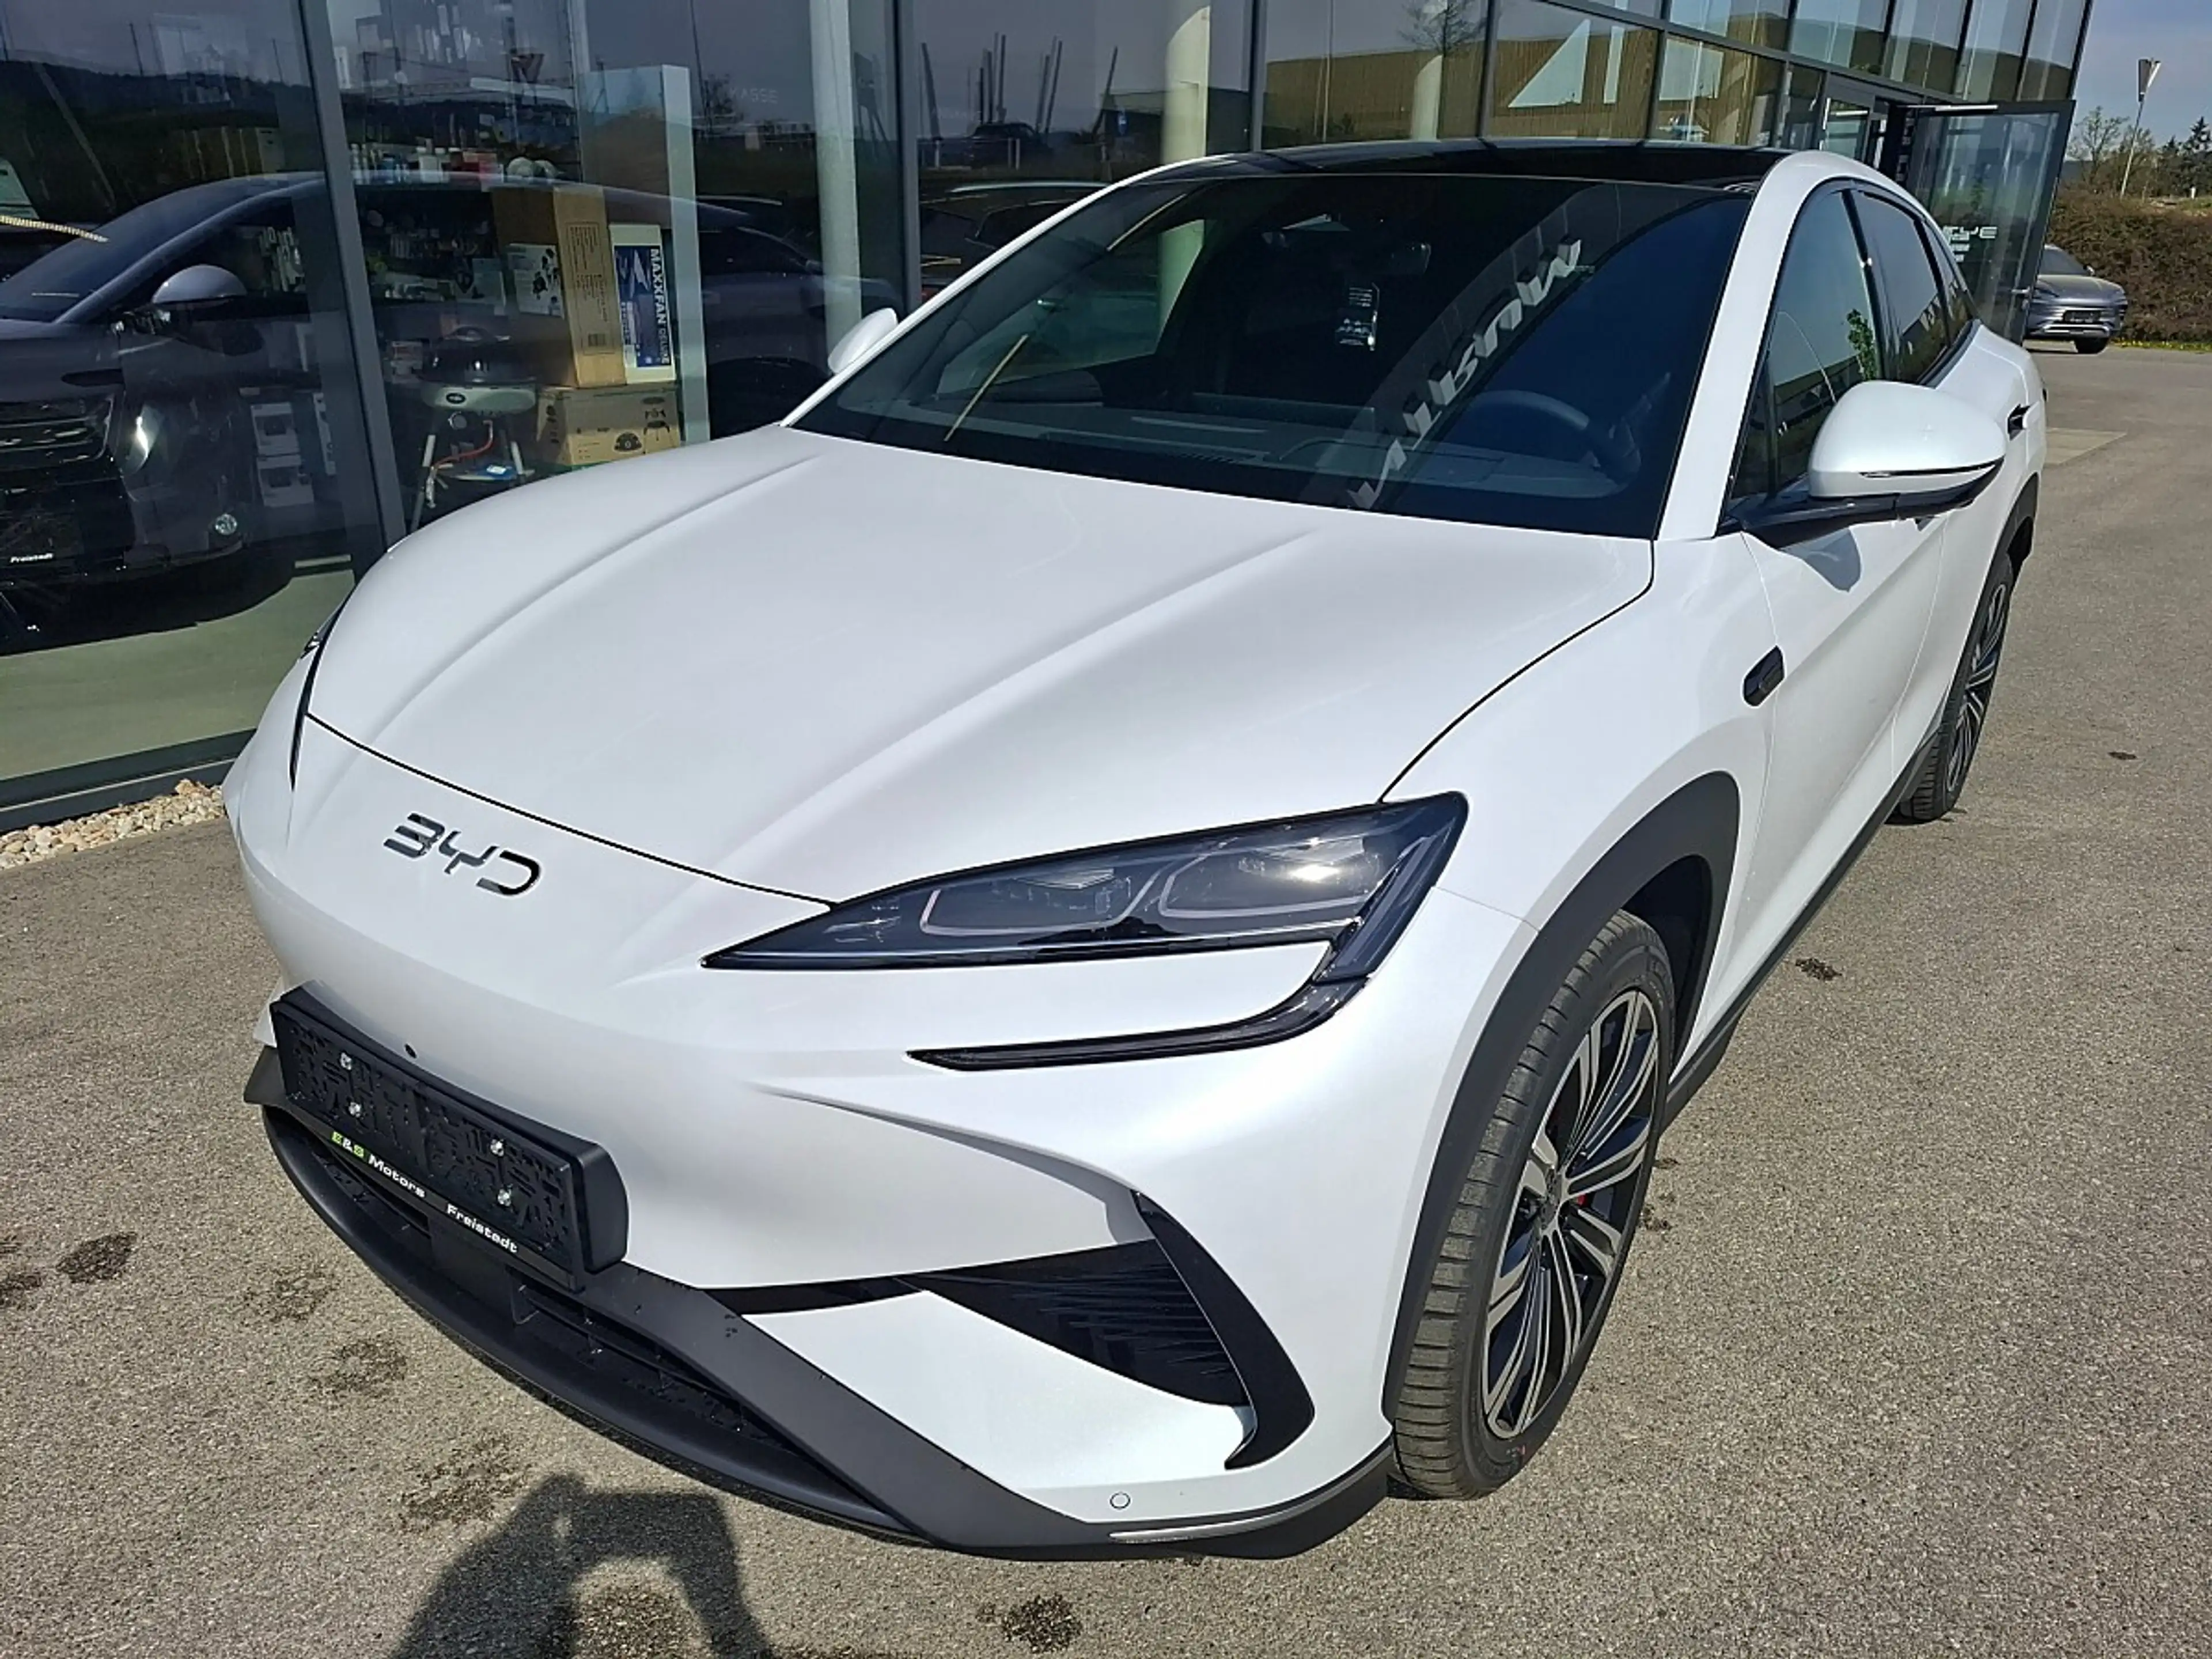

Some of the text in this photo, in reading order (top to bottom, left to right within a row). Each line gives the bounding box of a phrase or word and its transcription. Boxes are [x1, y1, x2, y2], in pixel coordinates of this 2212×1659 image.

[650, 248, 666, 324] MAXXFAN
[383, 812, 540, 896] BYD
[368, 1154, 426, 1198] Motors
[447, 1203, 518, 1253] Freistadt
